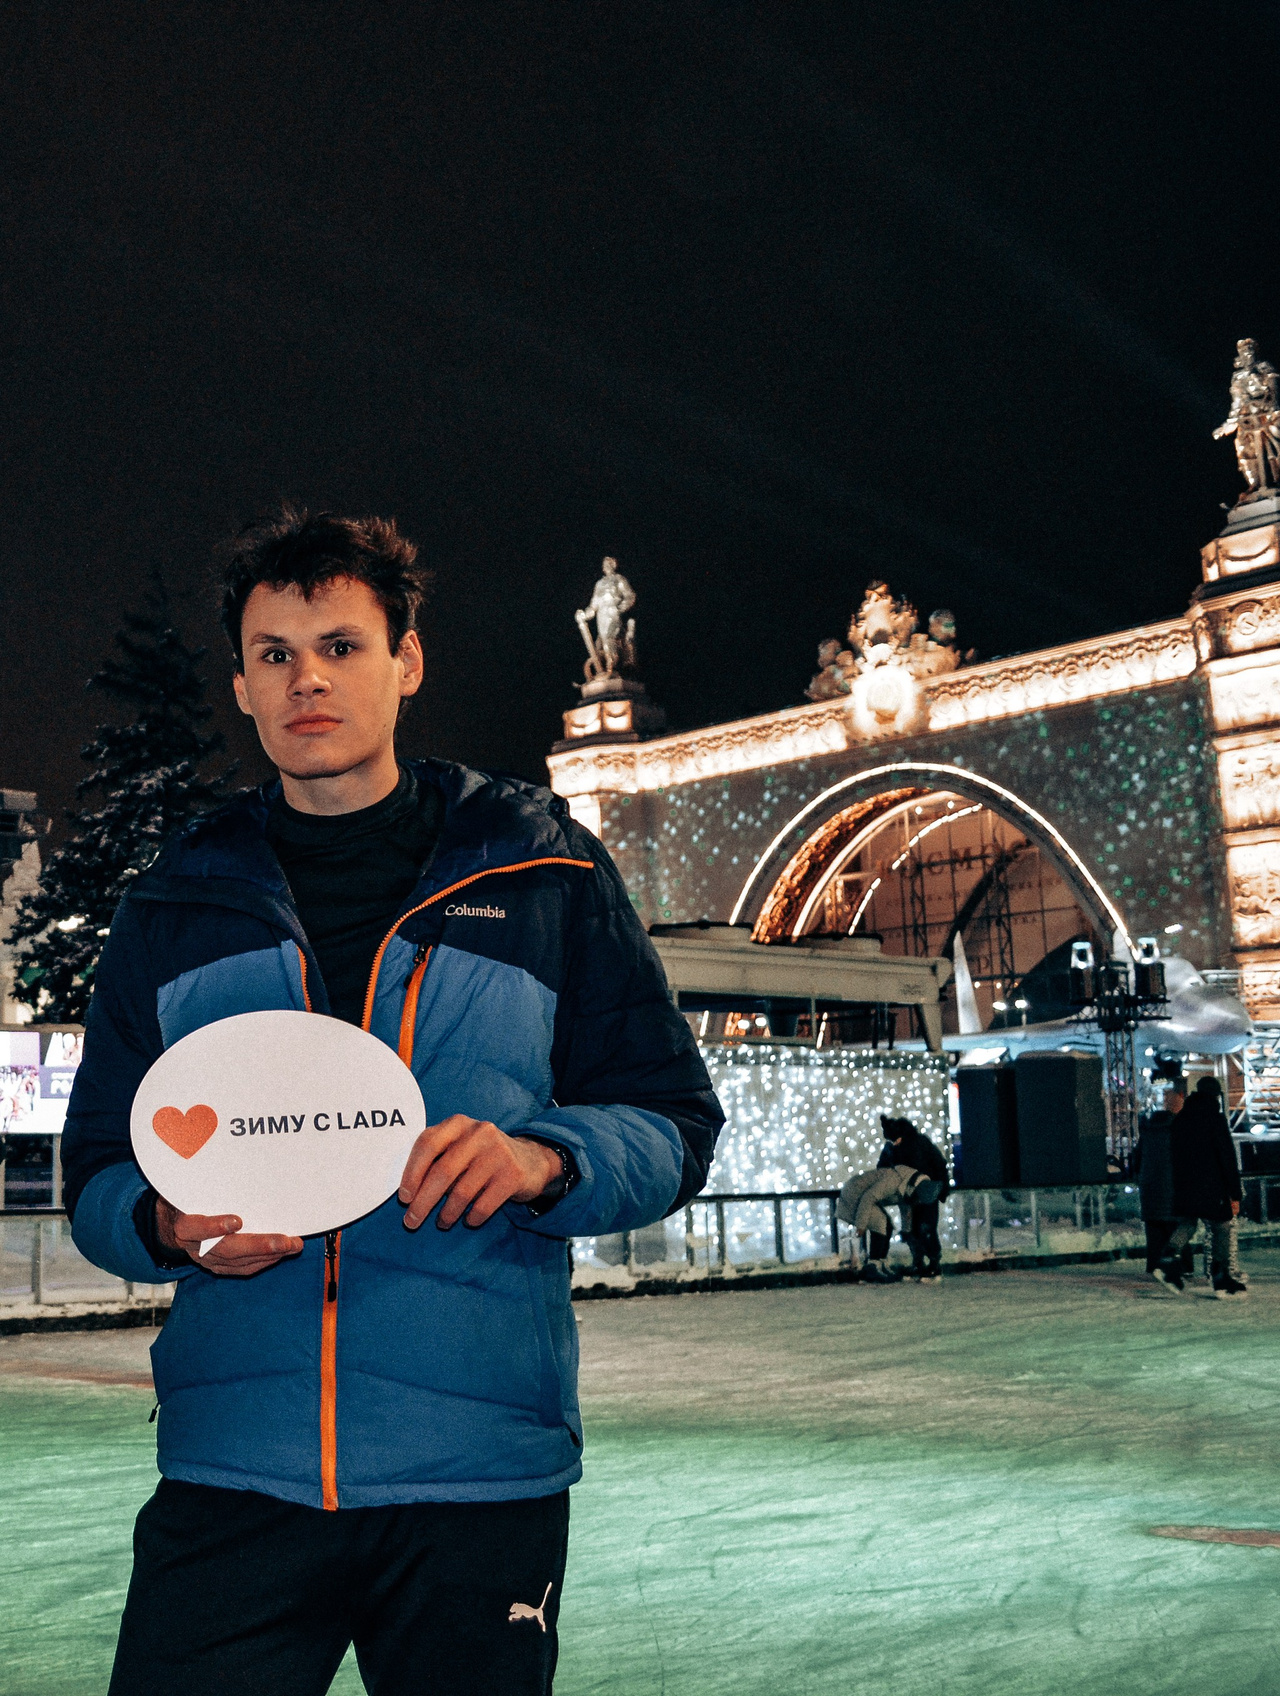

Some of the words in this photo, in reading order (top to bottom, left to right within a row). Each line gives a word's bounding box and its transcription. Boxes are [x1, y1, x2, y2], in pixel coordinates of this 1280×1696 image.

[444, 903, 506, 919] Columbia
[229, 1114, 306, 1137] ЗИМУ
[313, 1112, 331, 1132] С
[336, 1108, 406, 1130] LADA
